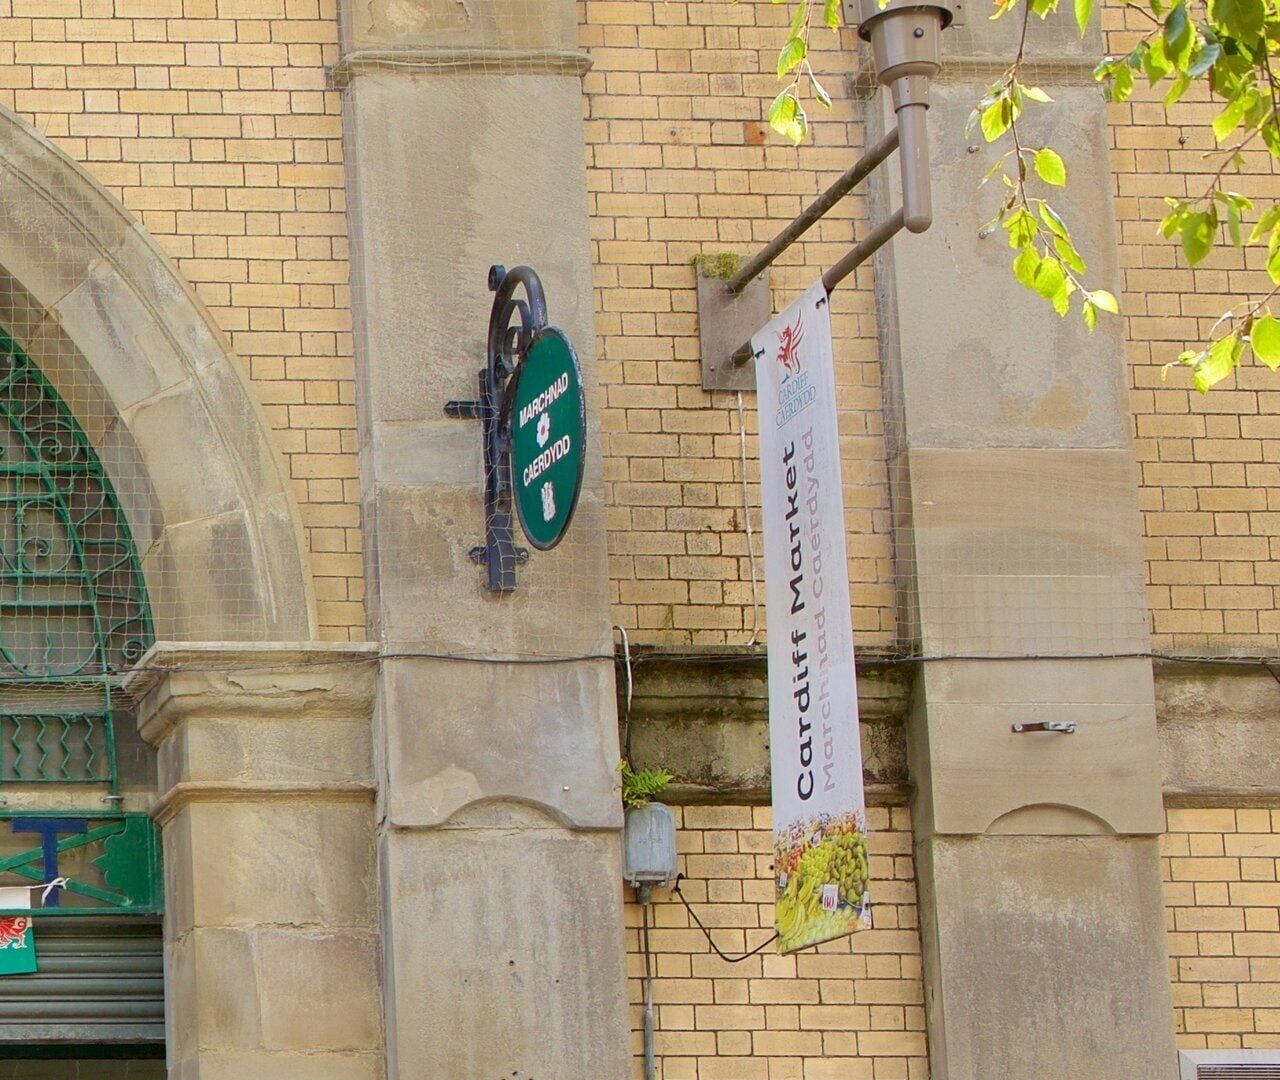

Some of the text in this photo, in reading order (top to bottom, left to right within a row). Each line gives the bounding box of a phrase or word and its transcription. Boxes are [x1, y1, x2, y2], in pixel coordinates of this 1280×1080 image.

[519, 372, 569, 428] MARCHNAD
[776, 386, 816, 426] CAERDYDD
[778, 373, 809, 404] CARDIFF
[523, 435, 570, 487] CAERDYDD
[802, 427, 824, 599] Caerdydd
[783, 440, 814, 801] Cardiff Market
